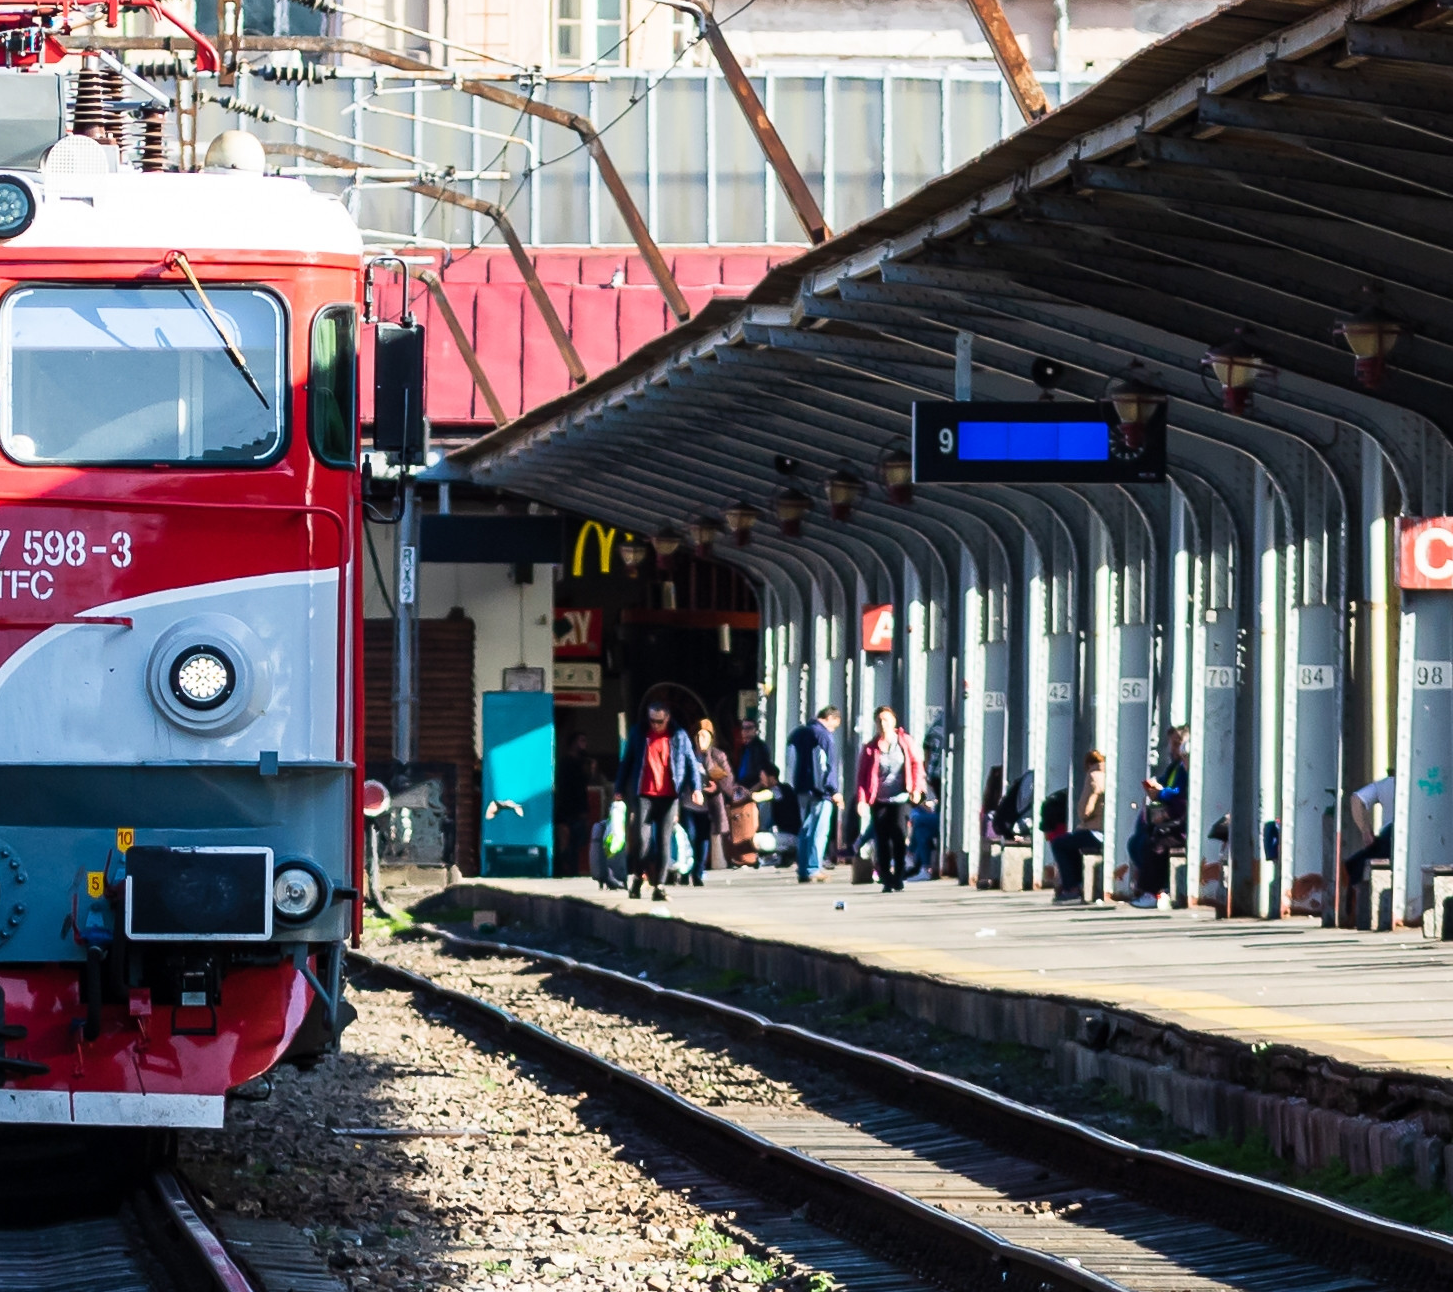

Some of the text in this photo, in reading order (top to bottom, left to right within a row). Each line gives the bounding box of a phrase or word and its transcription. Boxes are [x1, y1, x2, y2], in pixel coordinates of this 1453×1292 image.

[939, 428, 953, 454] 9
[22, 530, 132, 568] 598-3
[871, 610, 893, 646] A
[1208, 669, 1229, 687] 70
[1300, 668, 1324, 686] 84
[1416, 666, 1444, 686] 98
[1049, 684, 1069, 700] 42
[118, 832, 133, 845] 10
[92, 877, 101, 892] 5
